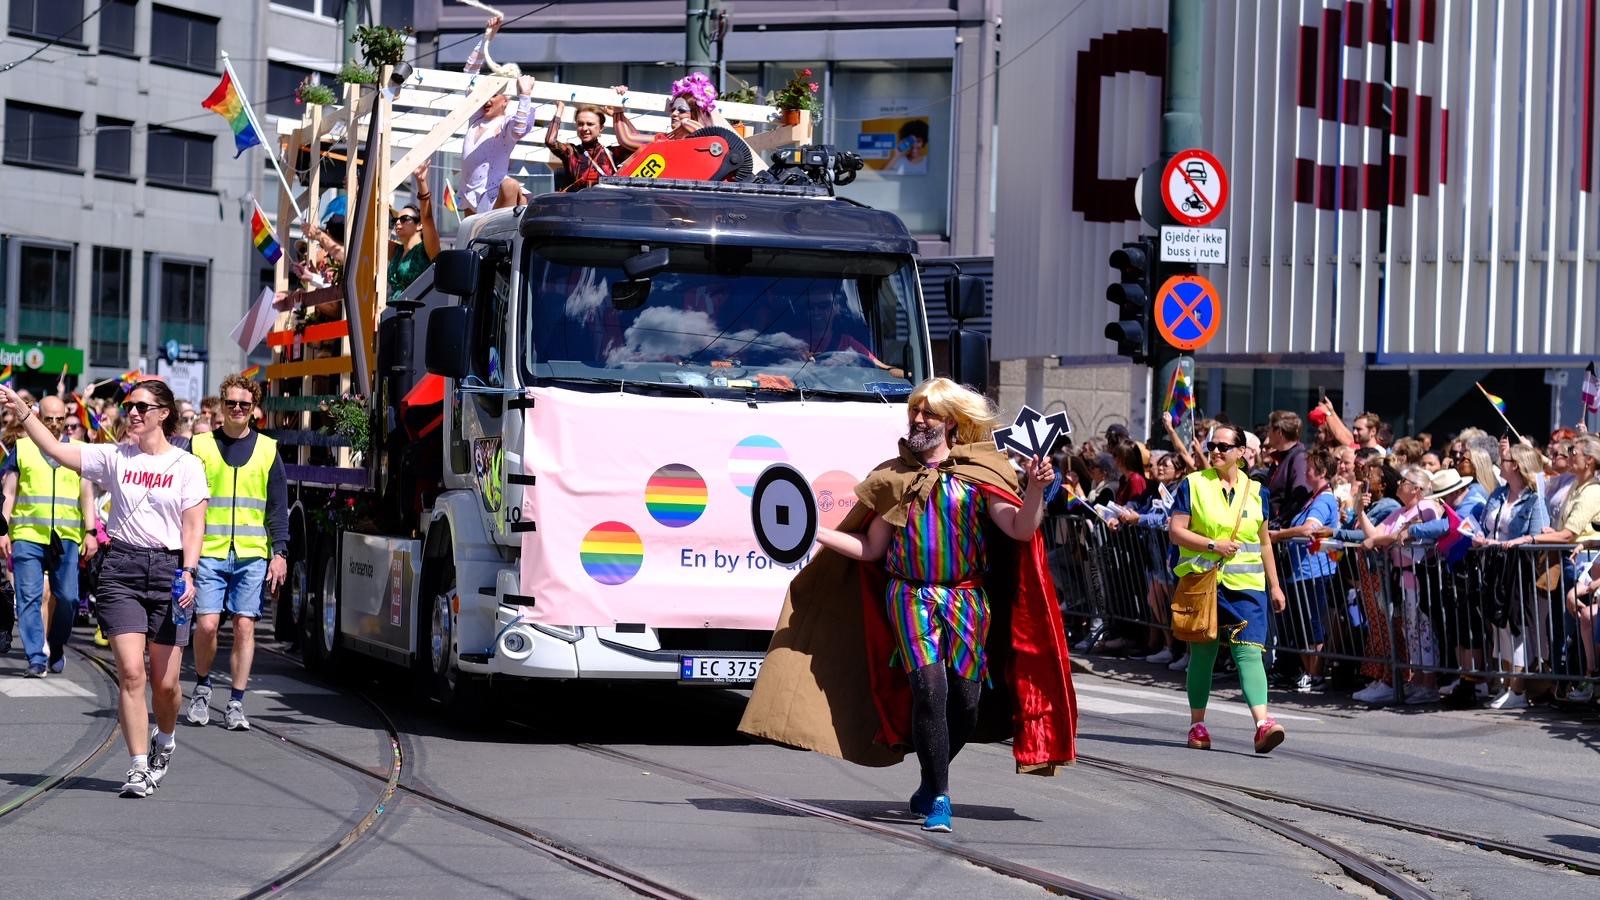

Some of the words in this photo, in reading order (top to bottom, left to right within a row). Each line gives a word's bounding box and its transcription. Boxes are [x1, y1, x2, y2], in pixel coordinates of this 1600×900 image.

[634, 158, 662, 178] ER
[1165, 231, 1200, 244] Gjelder
[1203, 232, 1222, 244] ikke
[1167, 245, 1191, 257] buss
[1193, 246, 1197, 257] i
[1199, 248, 1220, 258] rute
[680, 548, 707, 568] En
[714, 550, 739, 573] by
[700, 661, 719, 676] EC
[727, 660, 763, 677] 375
